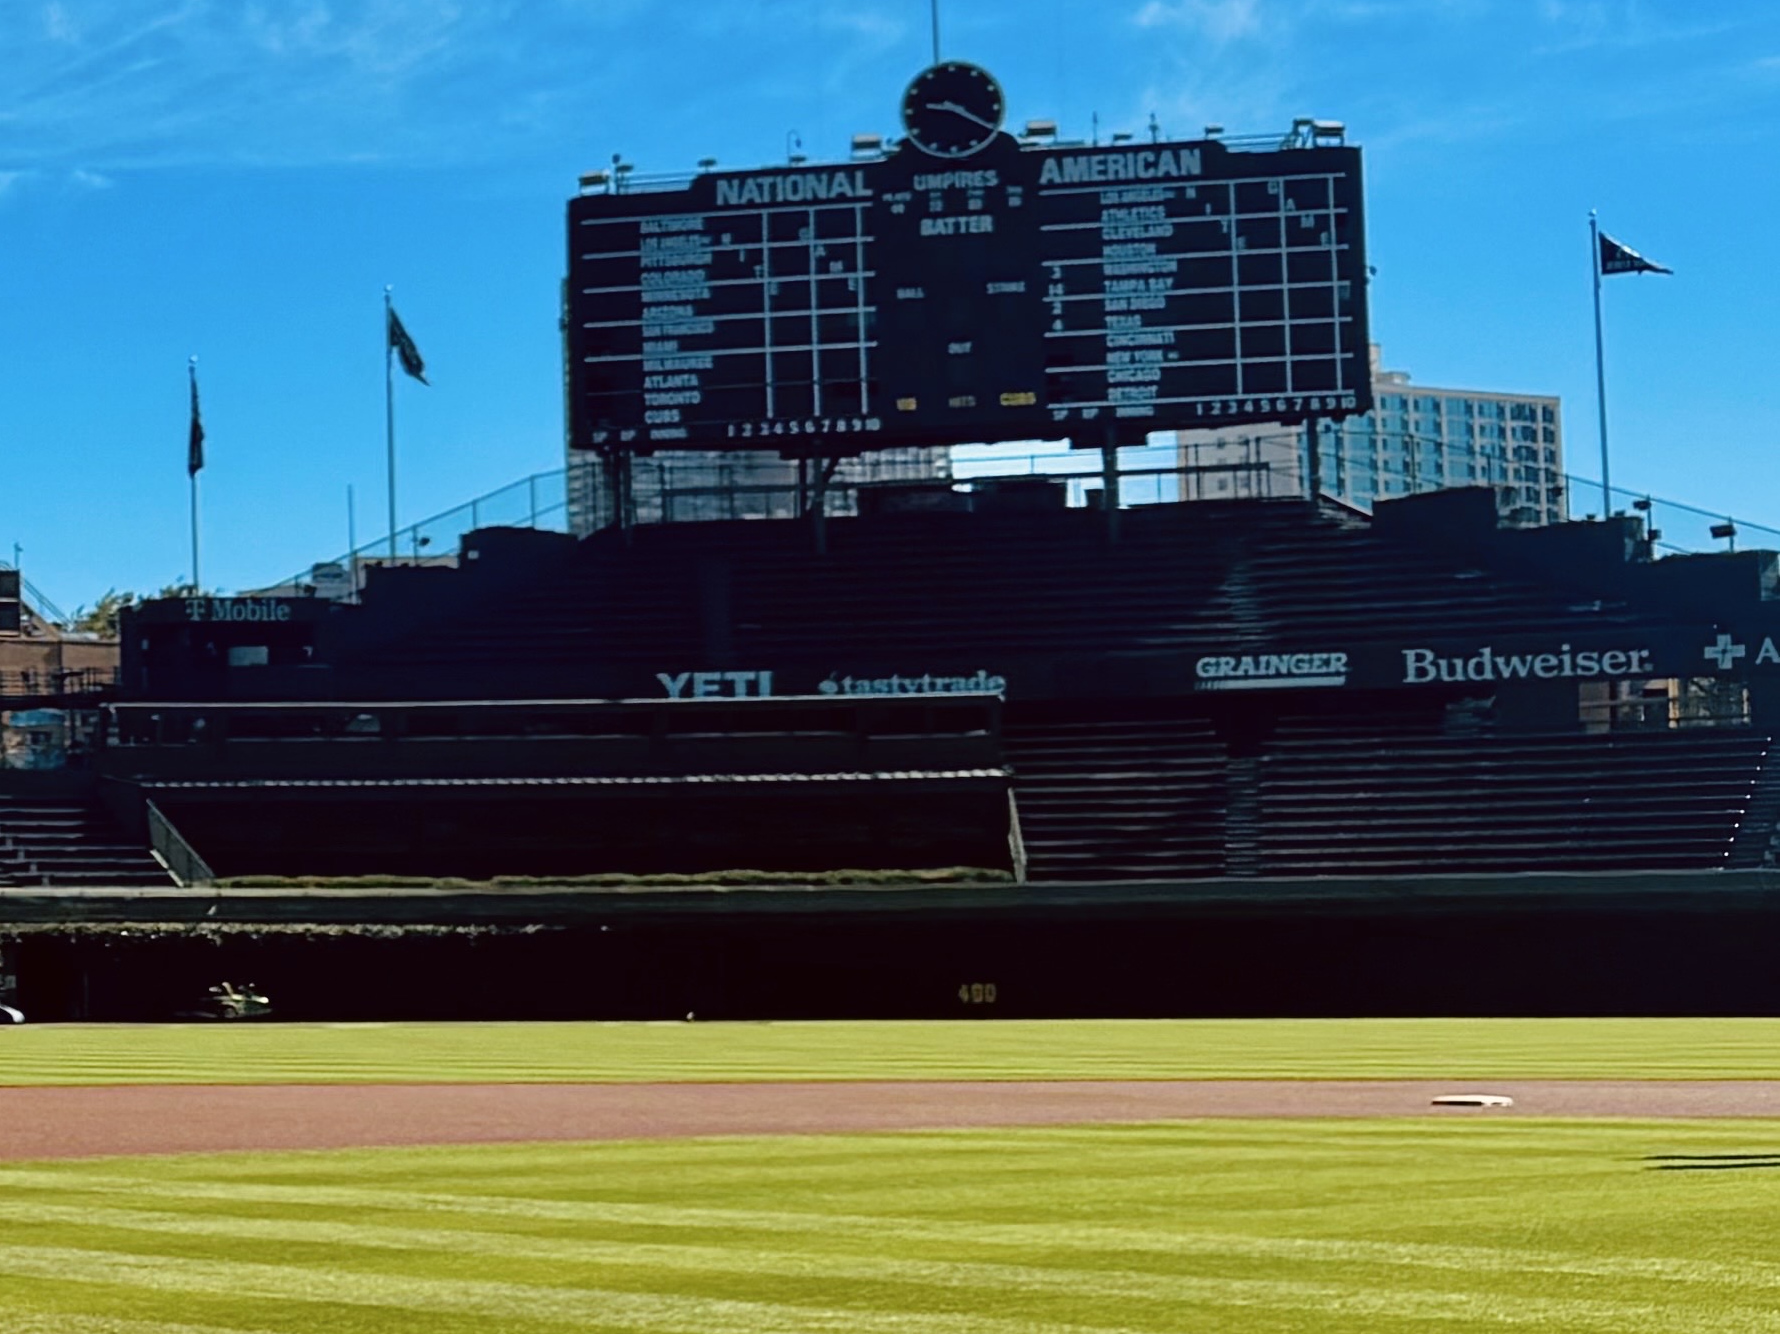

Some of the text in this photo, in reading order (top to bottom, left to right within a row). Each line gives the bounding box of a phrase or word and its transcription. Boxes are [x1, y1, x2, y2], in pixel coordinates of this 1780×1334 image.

[1039, 149, 1201, 185] AMERICAN
[716, 170, 873, 205] NATIONAL
[914, 170, 998, 190] UMPIRES
[920, 215, 993, 236] BATTER
[644, 373, 699, 389] ATLANTA
[644, 390, 701, 406] TORONTO
[1210, 402, 1221, 415] 2
[1228, 402, 1238, 414] 3
[1244, 401, 1254, 413] 4
[1260, 400, 1270, 413] 5
[1276, 399, 1287, 412] 6
[1293, 399, 1303, 411] 7
[1310, 398, 1320, 411] 8
[1326, 397, 1336, 410] 9
[1341, 396, 1356, 409] 10
[644, 409, 681, 424] CUBS
[742, 424, 752, 437] 2
[773, 422, 783, 434] 4
[789, 421, 799, 434] 5
[805, 421, 815, 433] 6
[821, 420, 830, 432] 7
[836, 419, 846, 432] 8
[852, 419, 862, 431] 9
[865, 418, 880, 431] 10
[1196, 652, 1348, 678] GRAINGER
[1402, 644, 1651, 684] Budweiser
[655, 671, 774, 698] YETI
[841, 670, 1006, 695] tastytrade
